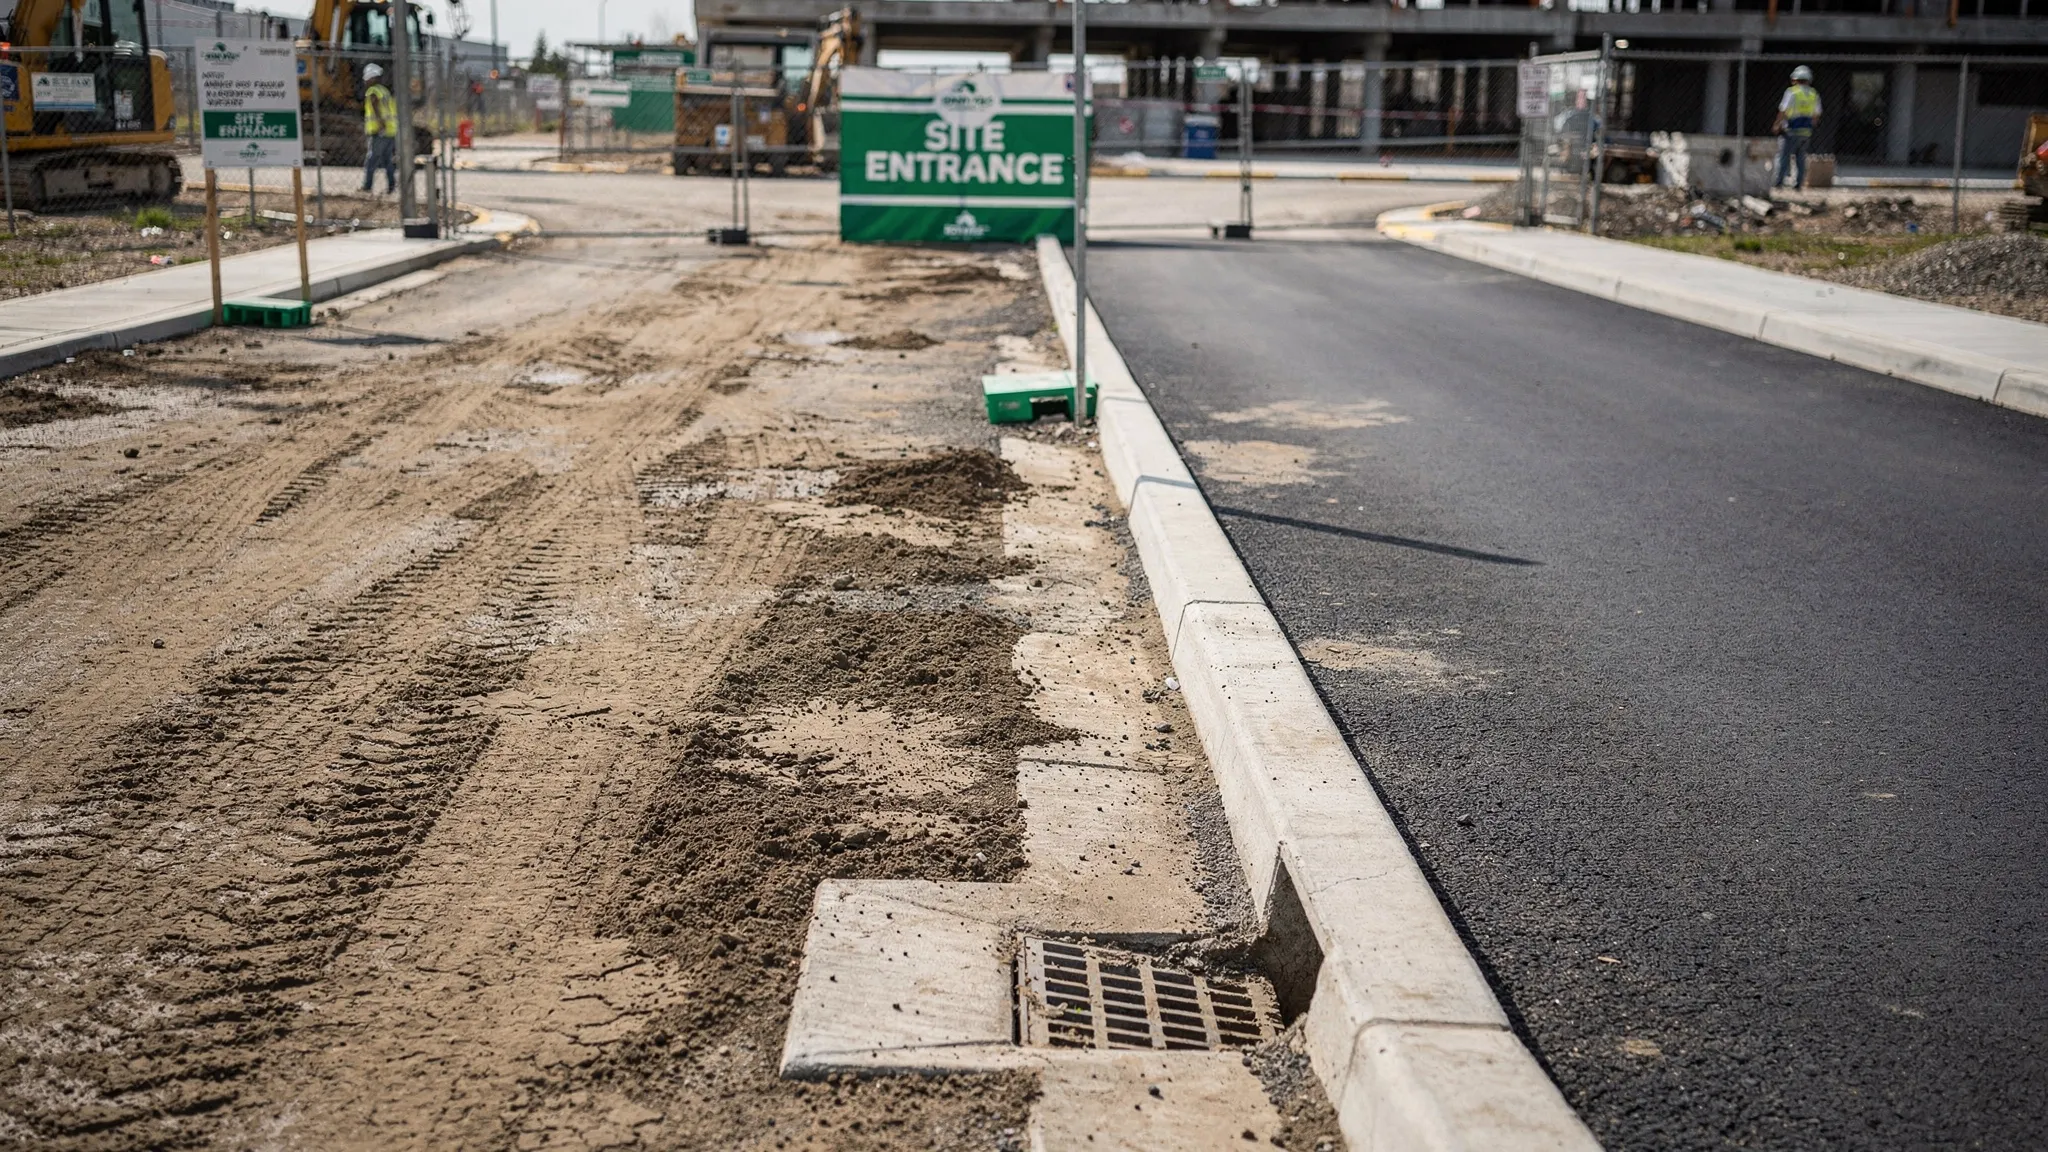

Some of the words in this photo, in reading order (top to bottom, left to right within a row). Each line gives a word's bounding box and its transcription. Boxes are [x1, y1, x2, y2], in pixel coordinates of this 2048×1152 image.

[234, 112, 265, 124] SITE
[218, 124, 287, 137] ENTRANCE
[923, 120, 1005, 151] SITE
[865, 151, 1064, 184] ENTRANCE
